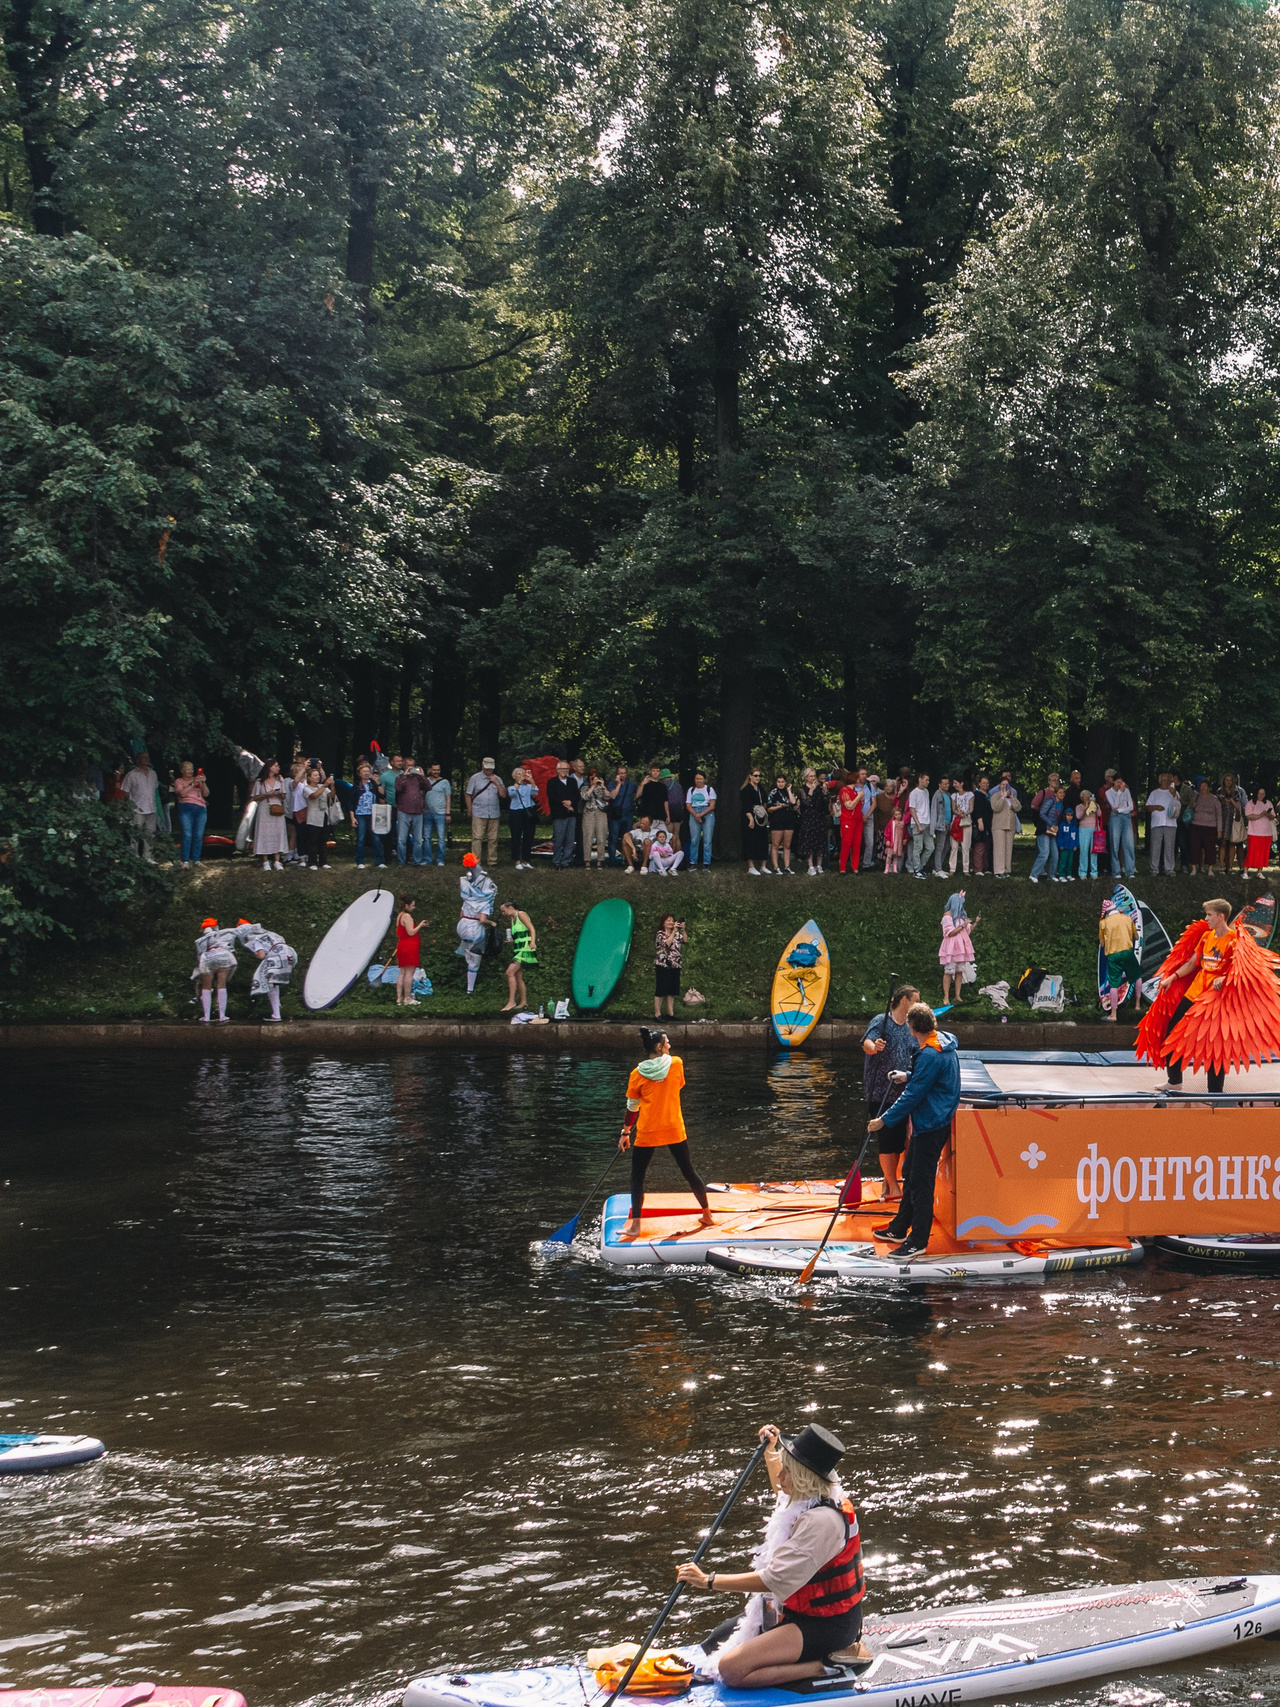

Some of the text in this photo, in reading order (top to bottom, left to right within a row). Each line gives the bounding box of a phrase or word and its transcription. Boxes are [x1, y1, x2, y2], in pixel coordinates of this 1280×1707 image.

[1187, 1245, 1246, 1259] RAVE BOARD
[1085, 1257, 1095, 1267] 11'
[895, 1687, 963, 1707] WAVE
